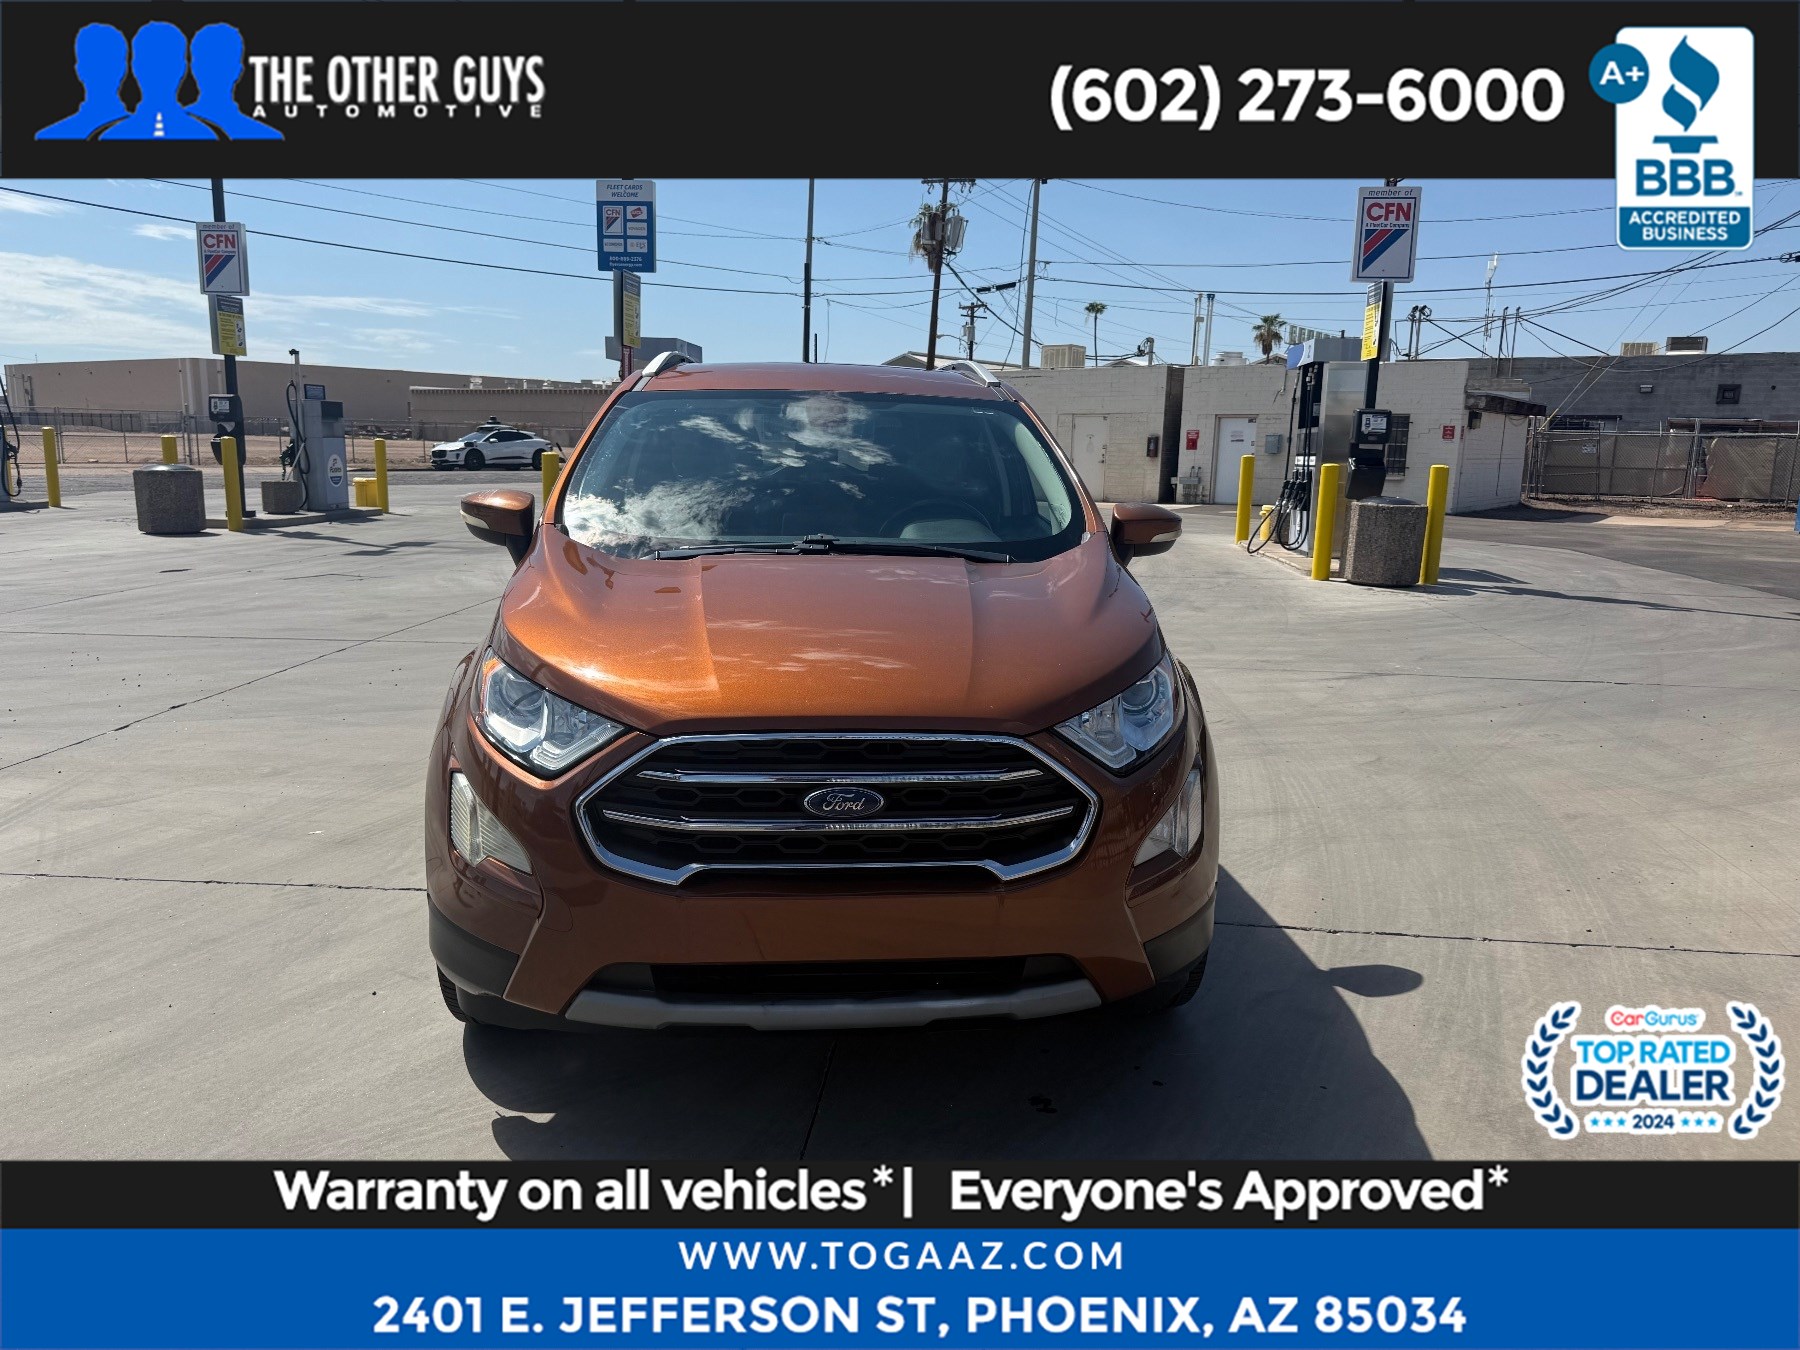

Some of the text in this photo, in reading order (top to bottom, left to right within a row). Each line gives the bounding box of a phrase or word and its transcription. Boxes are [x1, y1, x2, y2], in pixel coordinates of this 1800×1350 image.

[1368, 188, 1413, 196] member of
[605, 208, 620, 216] CFN
[1366, 202, 1412, 222] CFN
[203, 233, 236, 249] CFN
[822, 793, 866, 811] Ford
